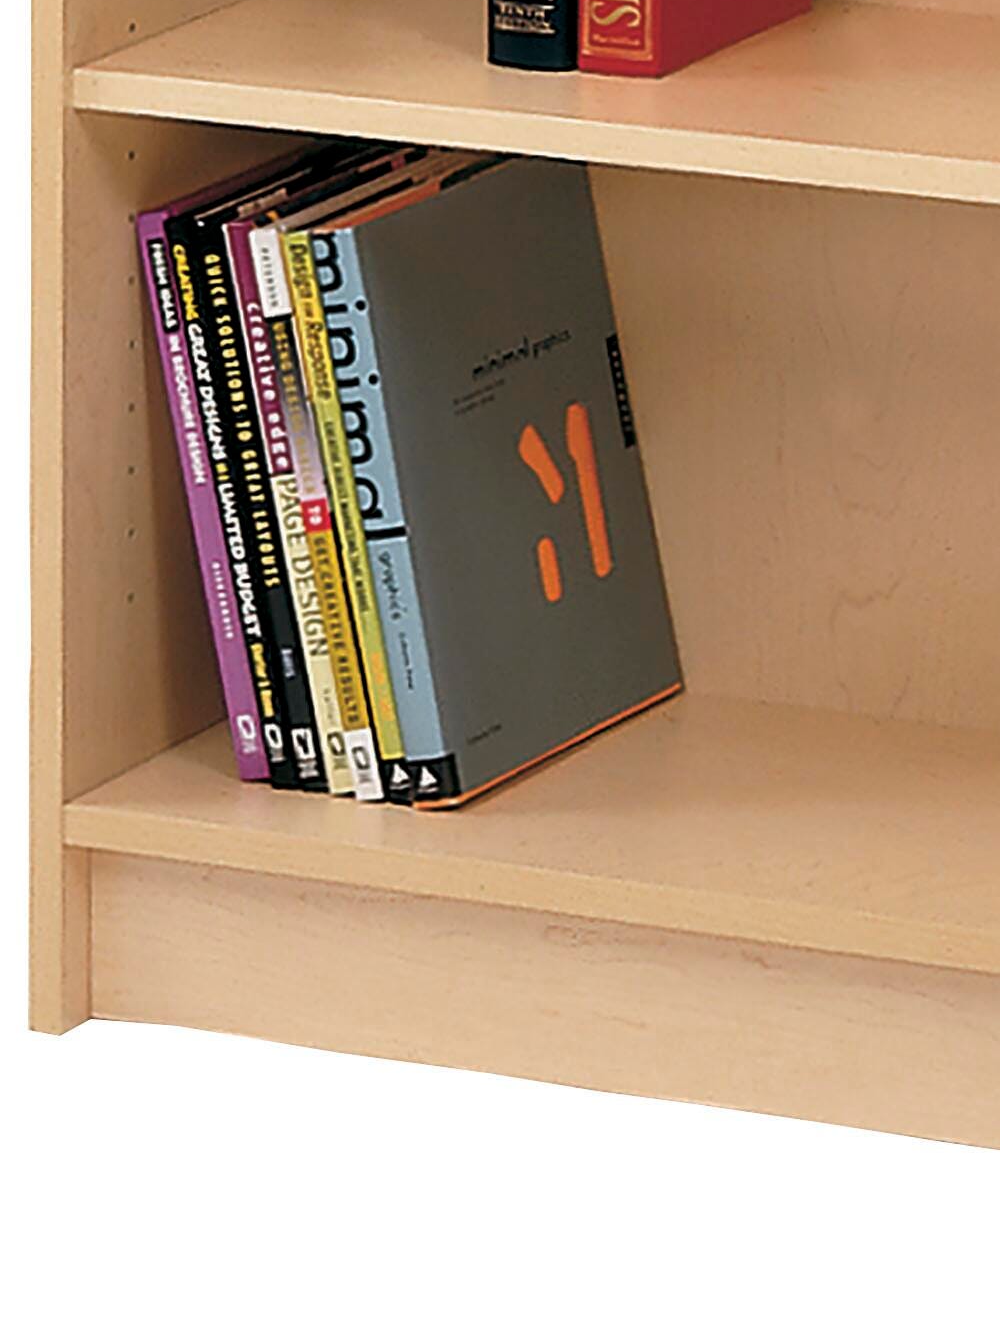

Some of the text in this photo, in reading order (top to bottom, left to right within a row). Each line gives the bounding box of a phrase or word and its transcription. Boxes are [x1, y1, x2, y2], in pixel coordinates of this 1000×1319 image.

[159, 287, 178, 328] IDEAS
[172, 243, 199, 321] CREATING
[169, 333, 182, 352] IN
[188, 322, 213, 382] GREAT
[289, 243, 314, 299] Design
[303, 322, 329, 399] Response
[172, 354, 197, 429] BROCHURE
[198, 385, 229, 461] DESIGNS
[205, 253, 281, 589] QUICK SOLUTIONS TO GREAT LAYOUTS
[247, 302, 290, 469] creative edge
[312, 232, 408, 542] minimal
[186, 431, 206, 485] DESIGN
[218, 481, 245, 561] LIMITED
[308, 504, 323, 526] TO
[314, 536, 330, 569] GET
[231, 561, 262, 639] BUDGET
[278, 476, 329, 659] PAGE DESIGN
[379, 550, 407, 622] graphics
[320, 571, 345, 649] CREATIVE
[336, 657, 360, 725] RESULTS
